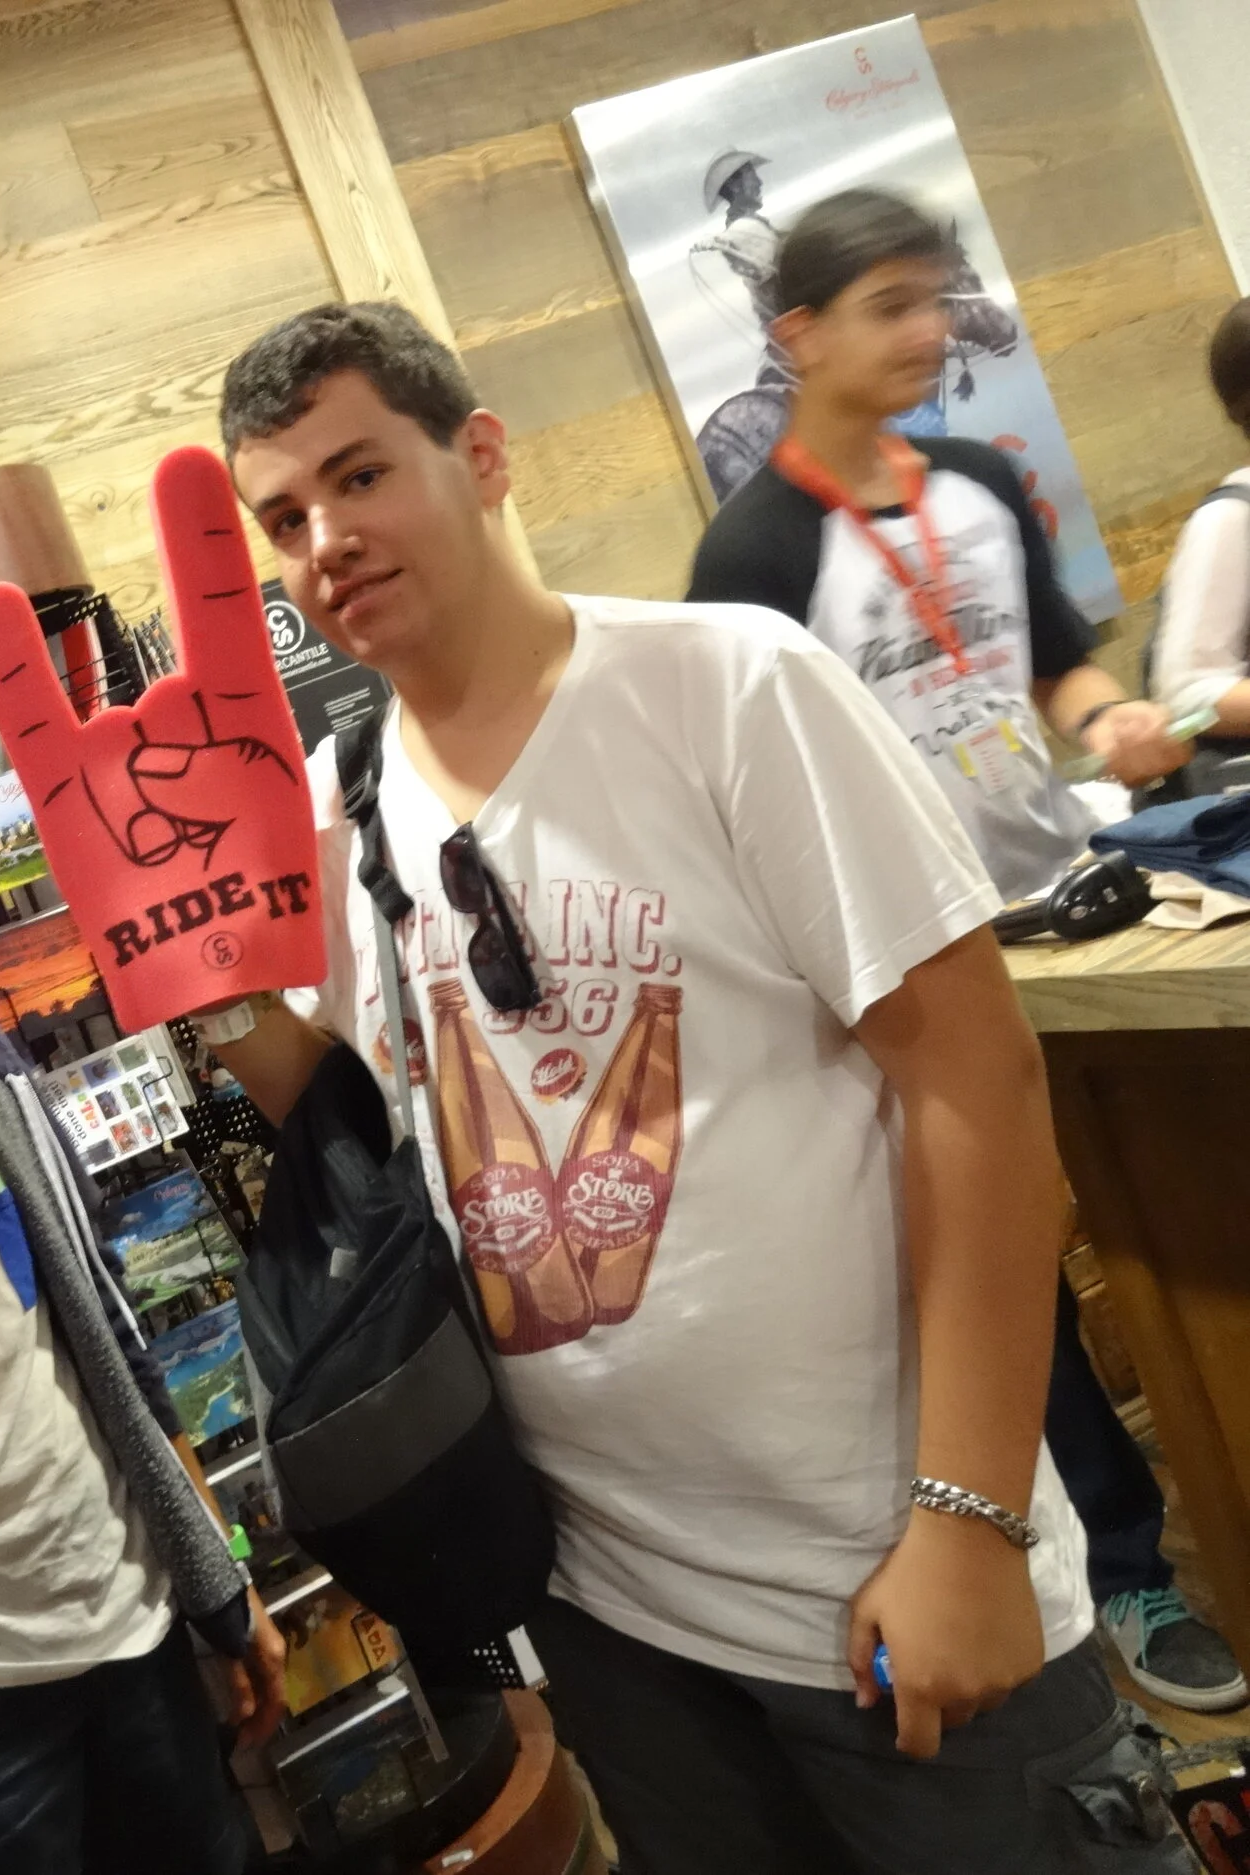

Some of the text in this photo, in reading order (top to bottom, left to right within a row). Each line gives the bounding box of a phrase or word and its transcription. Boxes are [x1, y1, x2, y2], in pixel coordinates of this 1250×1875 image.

[275, 643, 330, 671] RCANTILE
[104, 872, 312, 968] RIDE IT
[548, 879, 682, 976] INC.
[592, 1154, 640, 1173] SODA
[460, 1187, 547, 1236] STORE
[568, 1172, 655, 1213] STORE
